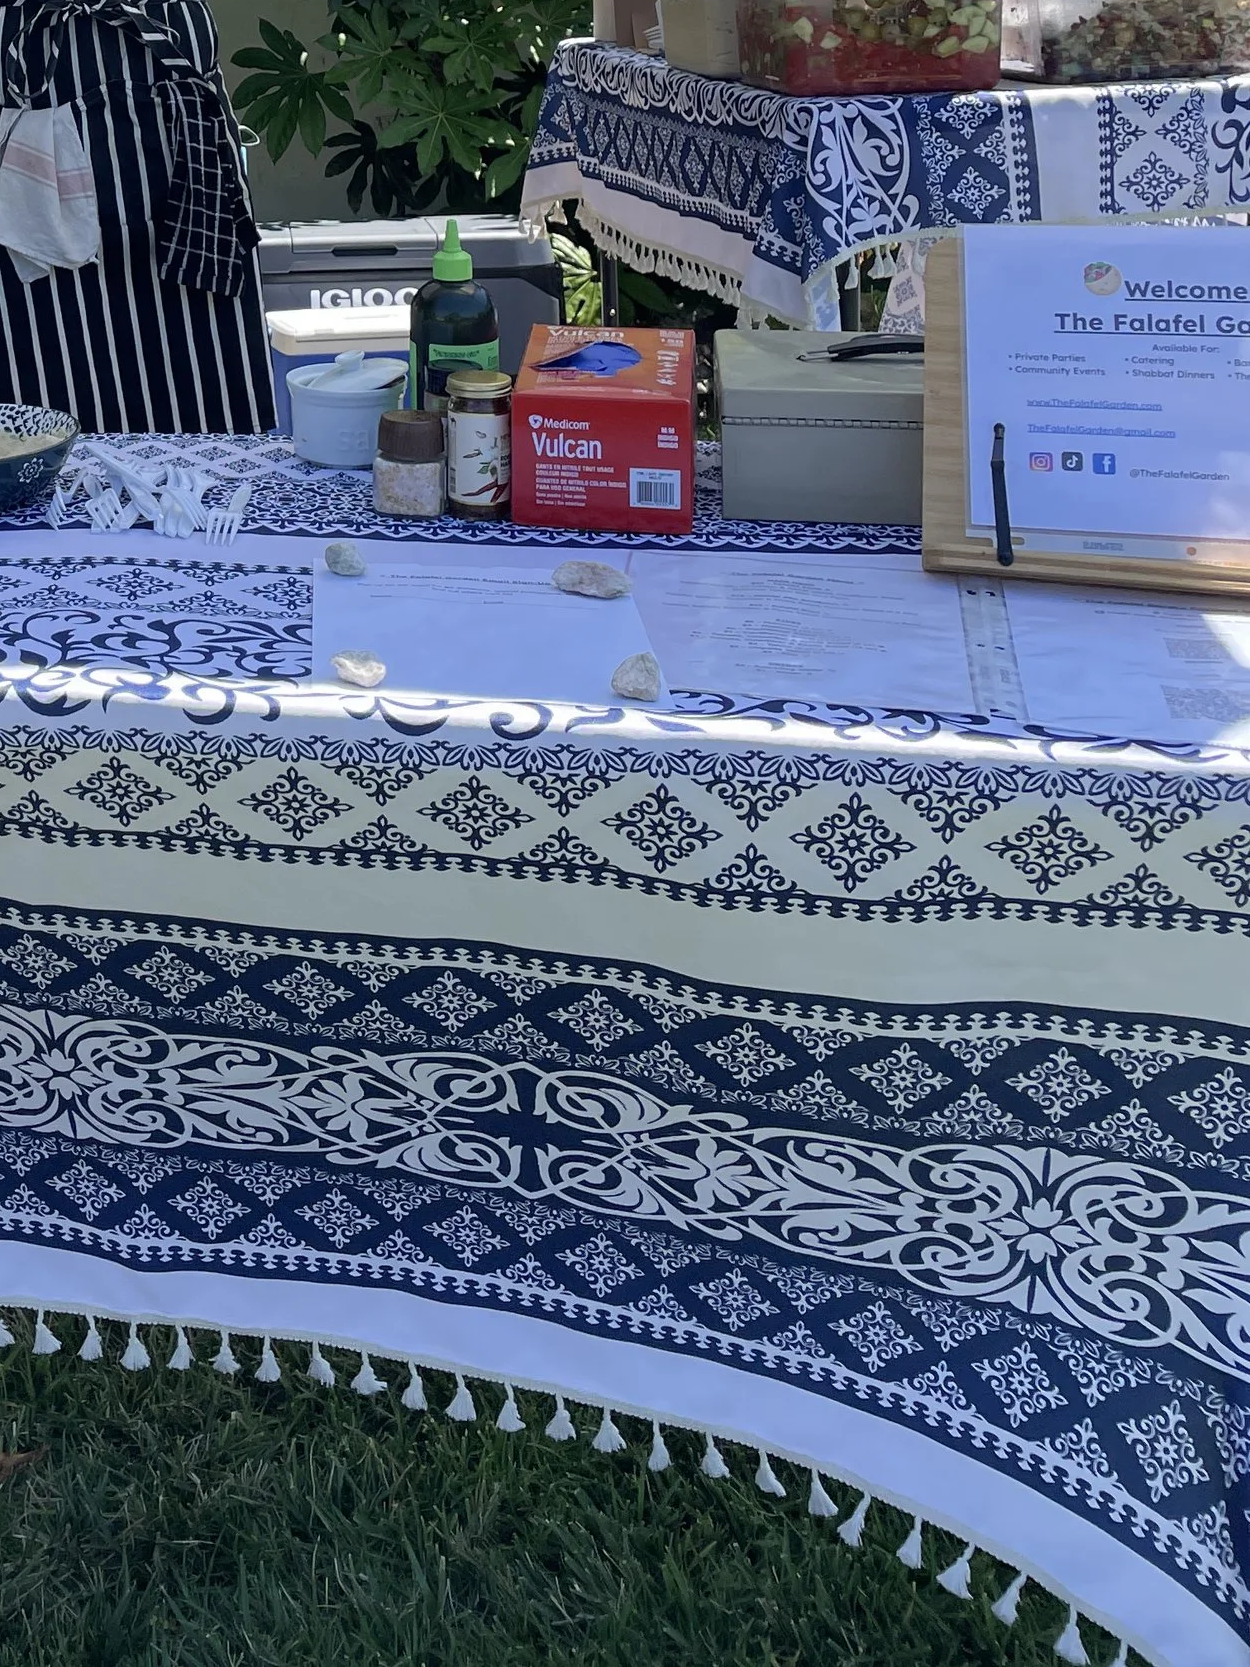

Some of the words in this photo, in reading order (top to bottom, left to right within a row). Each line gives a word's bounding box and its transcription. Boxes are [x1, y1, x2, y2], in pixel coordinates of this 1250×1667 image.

[1124, 280, 1248, 300] Welcome
[1054, 312, 1103, 331] The
[1114, 313, 1205, 333] Falafel
[1152, 343, 1198, 353] Available
[1014, 353, 1049, 362] Private
[1052, 353, 1085, 362] Parties
[1131, 356, 1175, 366] Catering
[1015, 365, 1070, 377] Community
[1073, 367, 1106, 376] Events
[1132, 368, 1174, 378] Shabbat
[1177, 370, 1215, 379] Dinners
[1027, 398, 1162, 411] www.TheFalafelGarden.com
[544, 418, 589, 430] Medicom
[1027, 423, 1176, 439] TheFalafelGarden@gmail.com
[532, 432, 602, 459] Vulcan
[562, 464, 580, 472] NITRILE
[1130, 469, 1230, 481] @TheFalafelGarden
